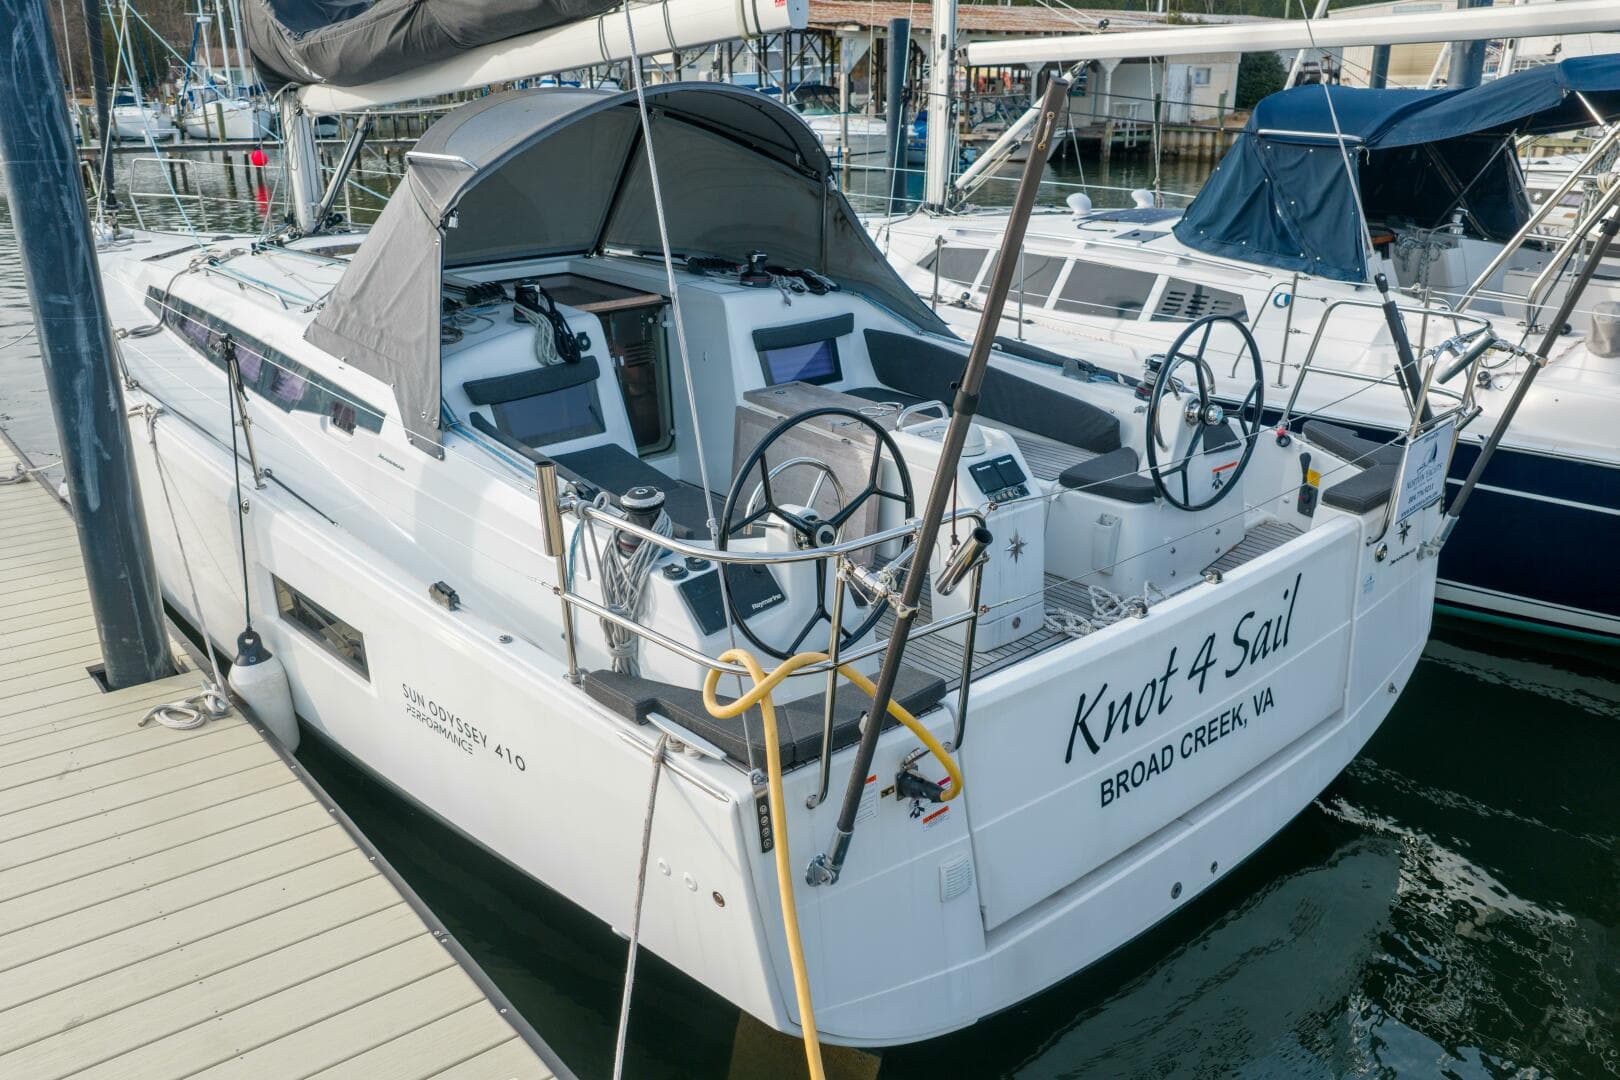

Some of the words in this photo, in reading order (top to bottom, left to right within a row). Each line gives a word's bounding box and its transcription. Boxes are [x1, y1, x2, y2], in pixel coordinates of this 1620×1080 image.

[752, 593, 782, 610] Raymarine
[1065, 646, 1178, 764] Knot
[1187, 632, 1217, 694] 4
[1225, 573, 1302, 678] Sail
[402, 683, 425, 708] SUN
[429, 701, 487, 748] ODYSSEY
[495, 744, 526, 771] 410
[406, 704, 473, 755] PERFORMANCE
[1101, 744, 1174, 808] BROAD
[1180, 703, 1248, 759] CREEK,
[1253, 687, 1275, 716] VA
